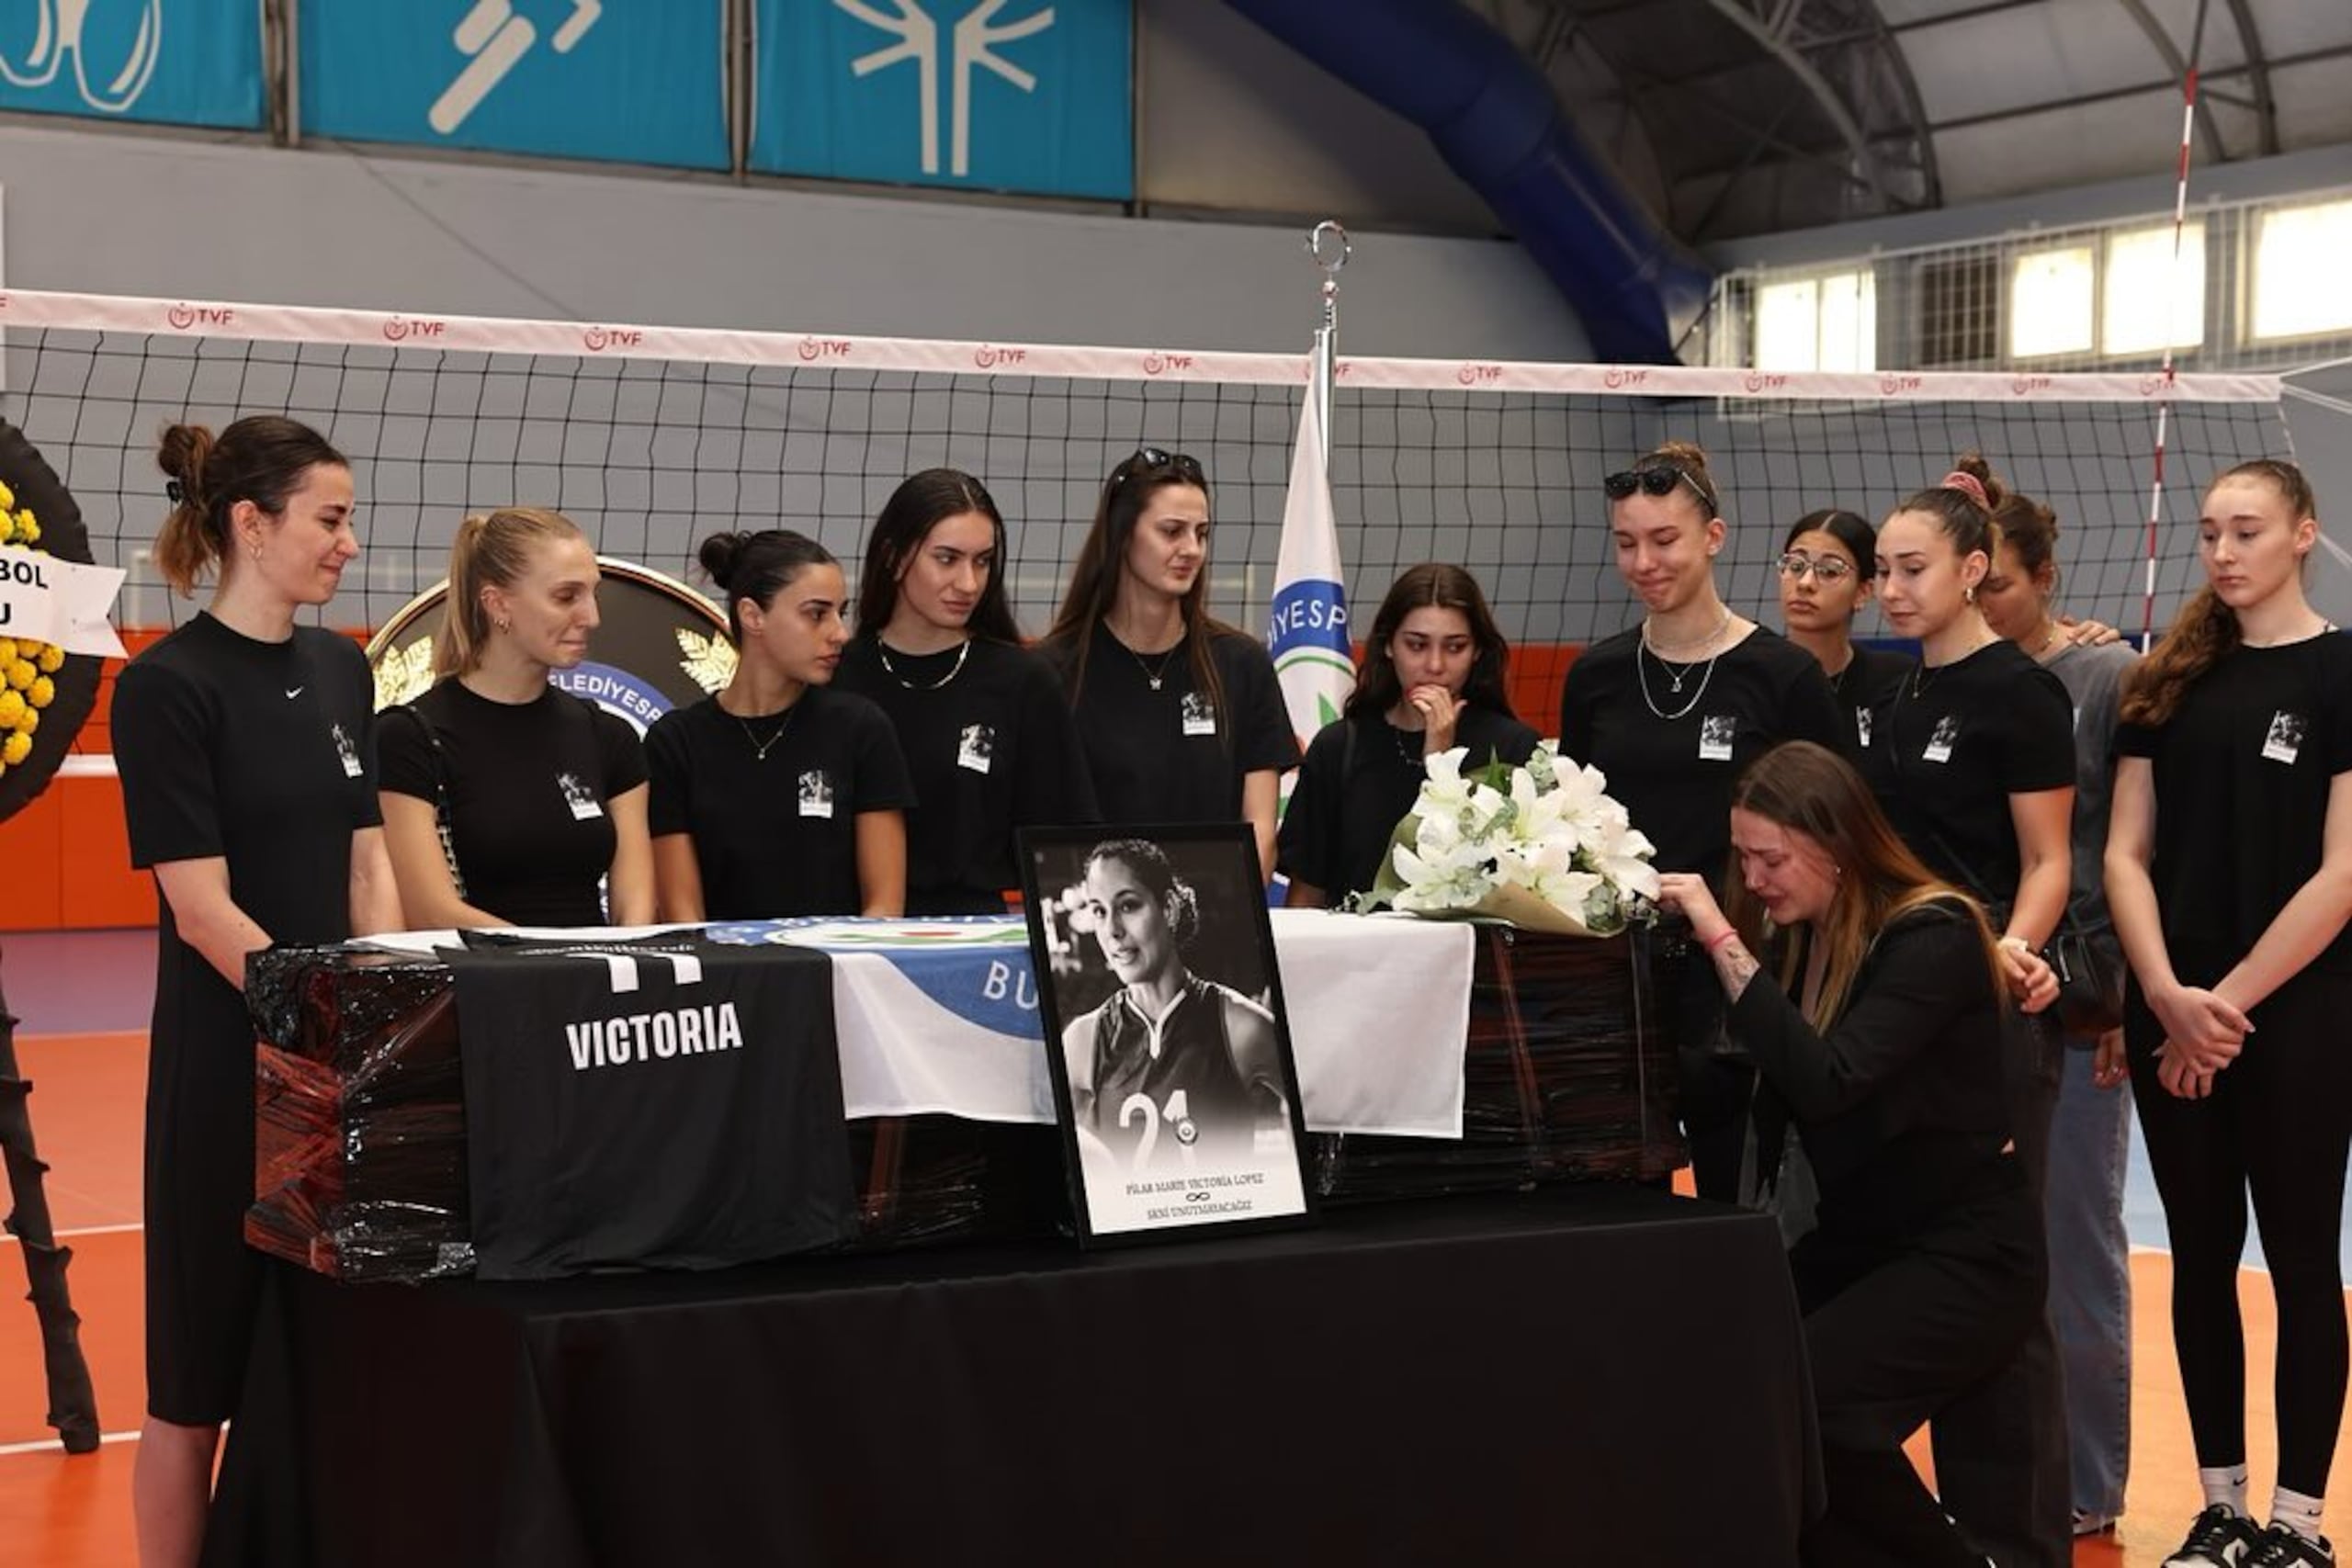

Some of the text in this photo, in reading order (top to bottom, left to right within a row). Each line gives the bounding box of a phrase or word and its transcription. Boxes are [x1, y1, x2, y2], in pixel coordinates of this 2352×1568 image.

[198, 309, 233, 324] TVF
[411, 321, 444, 336] TVF
[610, 332, 642, 345] TVF
[821, 342, 851, 356] TVF
[998, 350, 1025, 363] TVF
[1165, 356, 1192, 368] TVF
[1477, 367, 1502, 381] TVF
[1624, 370, 1647, 383] TVF
[1764, 375, 1787, 388] TVF
[982, 960, 1040, 1010] BU
[564, 1001, 743, 1070] VICTORIA
[1119, 1089, 1196, 1169] 21
